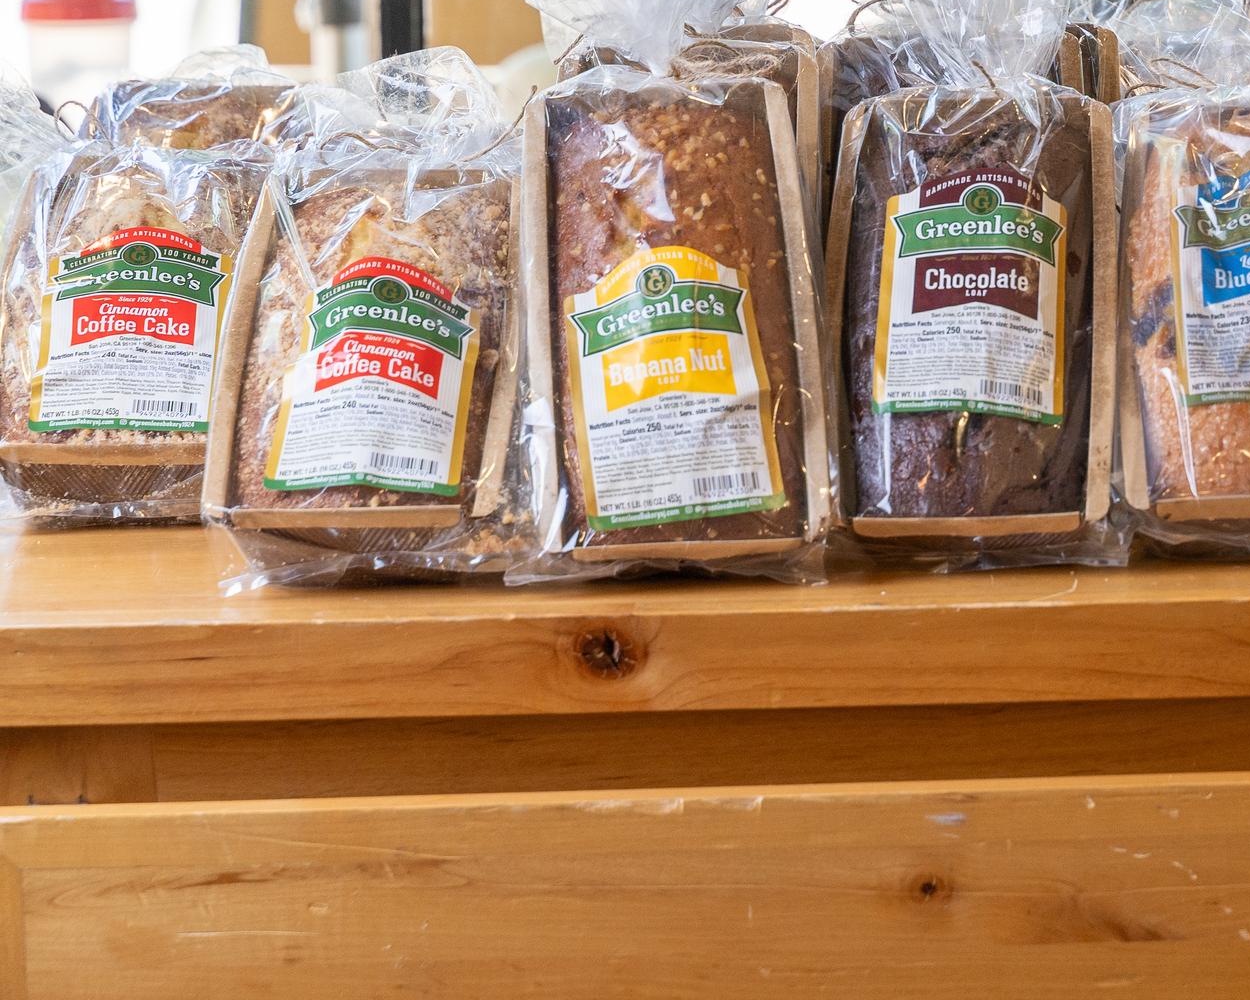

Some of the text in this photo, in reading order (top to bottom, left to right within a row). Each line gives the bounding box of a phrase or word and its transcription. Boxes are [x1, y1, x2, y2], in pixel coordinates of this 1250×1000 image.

[925, 174, 1041, 201] HANDMADE ARTISAN BRAD
[132, 229, 168, 240] ARTISAN
[170, 234, 194, 250] BREAD
[916, 215, 1044, 245] Greenlee's
[69, 248, 210, 269] CELEBRATING 100 YEARS!
[339, 261, 446, 296] HANDMADE ARTISAN BREAD
[925, 267, 1029, 292] Chocolate
[117, 295, 136, 303] Since
[321, 279, 369, 301] CELEBRATING
[414, 289, 431, 300] 100
[965, 289, 988, 297] LOAF
[98, 303, 169, 317] Cinnamon
[325, 304, 450, 338] Greenlee's
[597, 293, 725, 337] Greenlee's
[76, 315, 190, 337] Coffee Cake
[922, 326, 961, 337] Calories 250
[343, 339, 415, 361] Cinnamon
[320, 353, 434, 387] Coffee Cake
[608, 347, 726, 387] Banana Nut
[41, 411, 57, 419] NET
[341, 400, 357, 410] 240
[622, 422, 662, 437] Calories 250
[600, 503, 613, 512] NET
